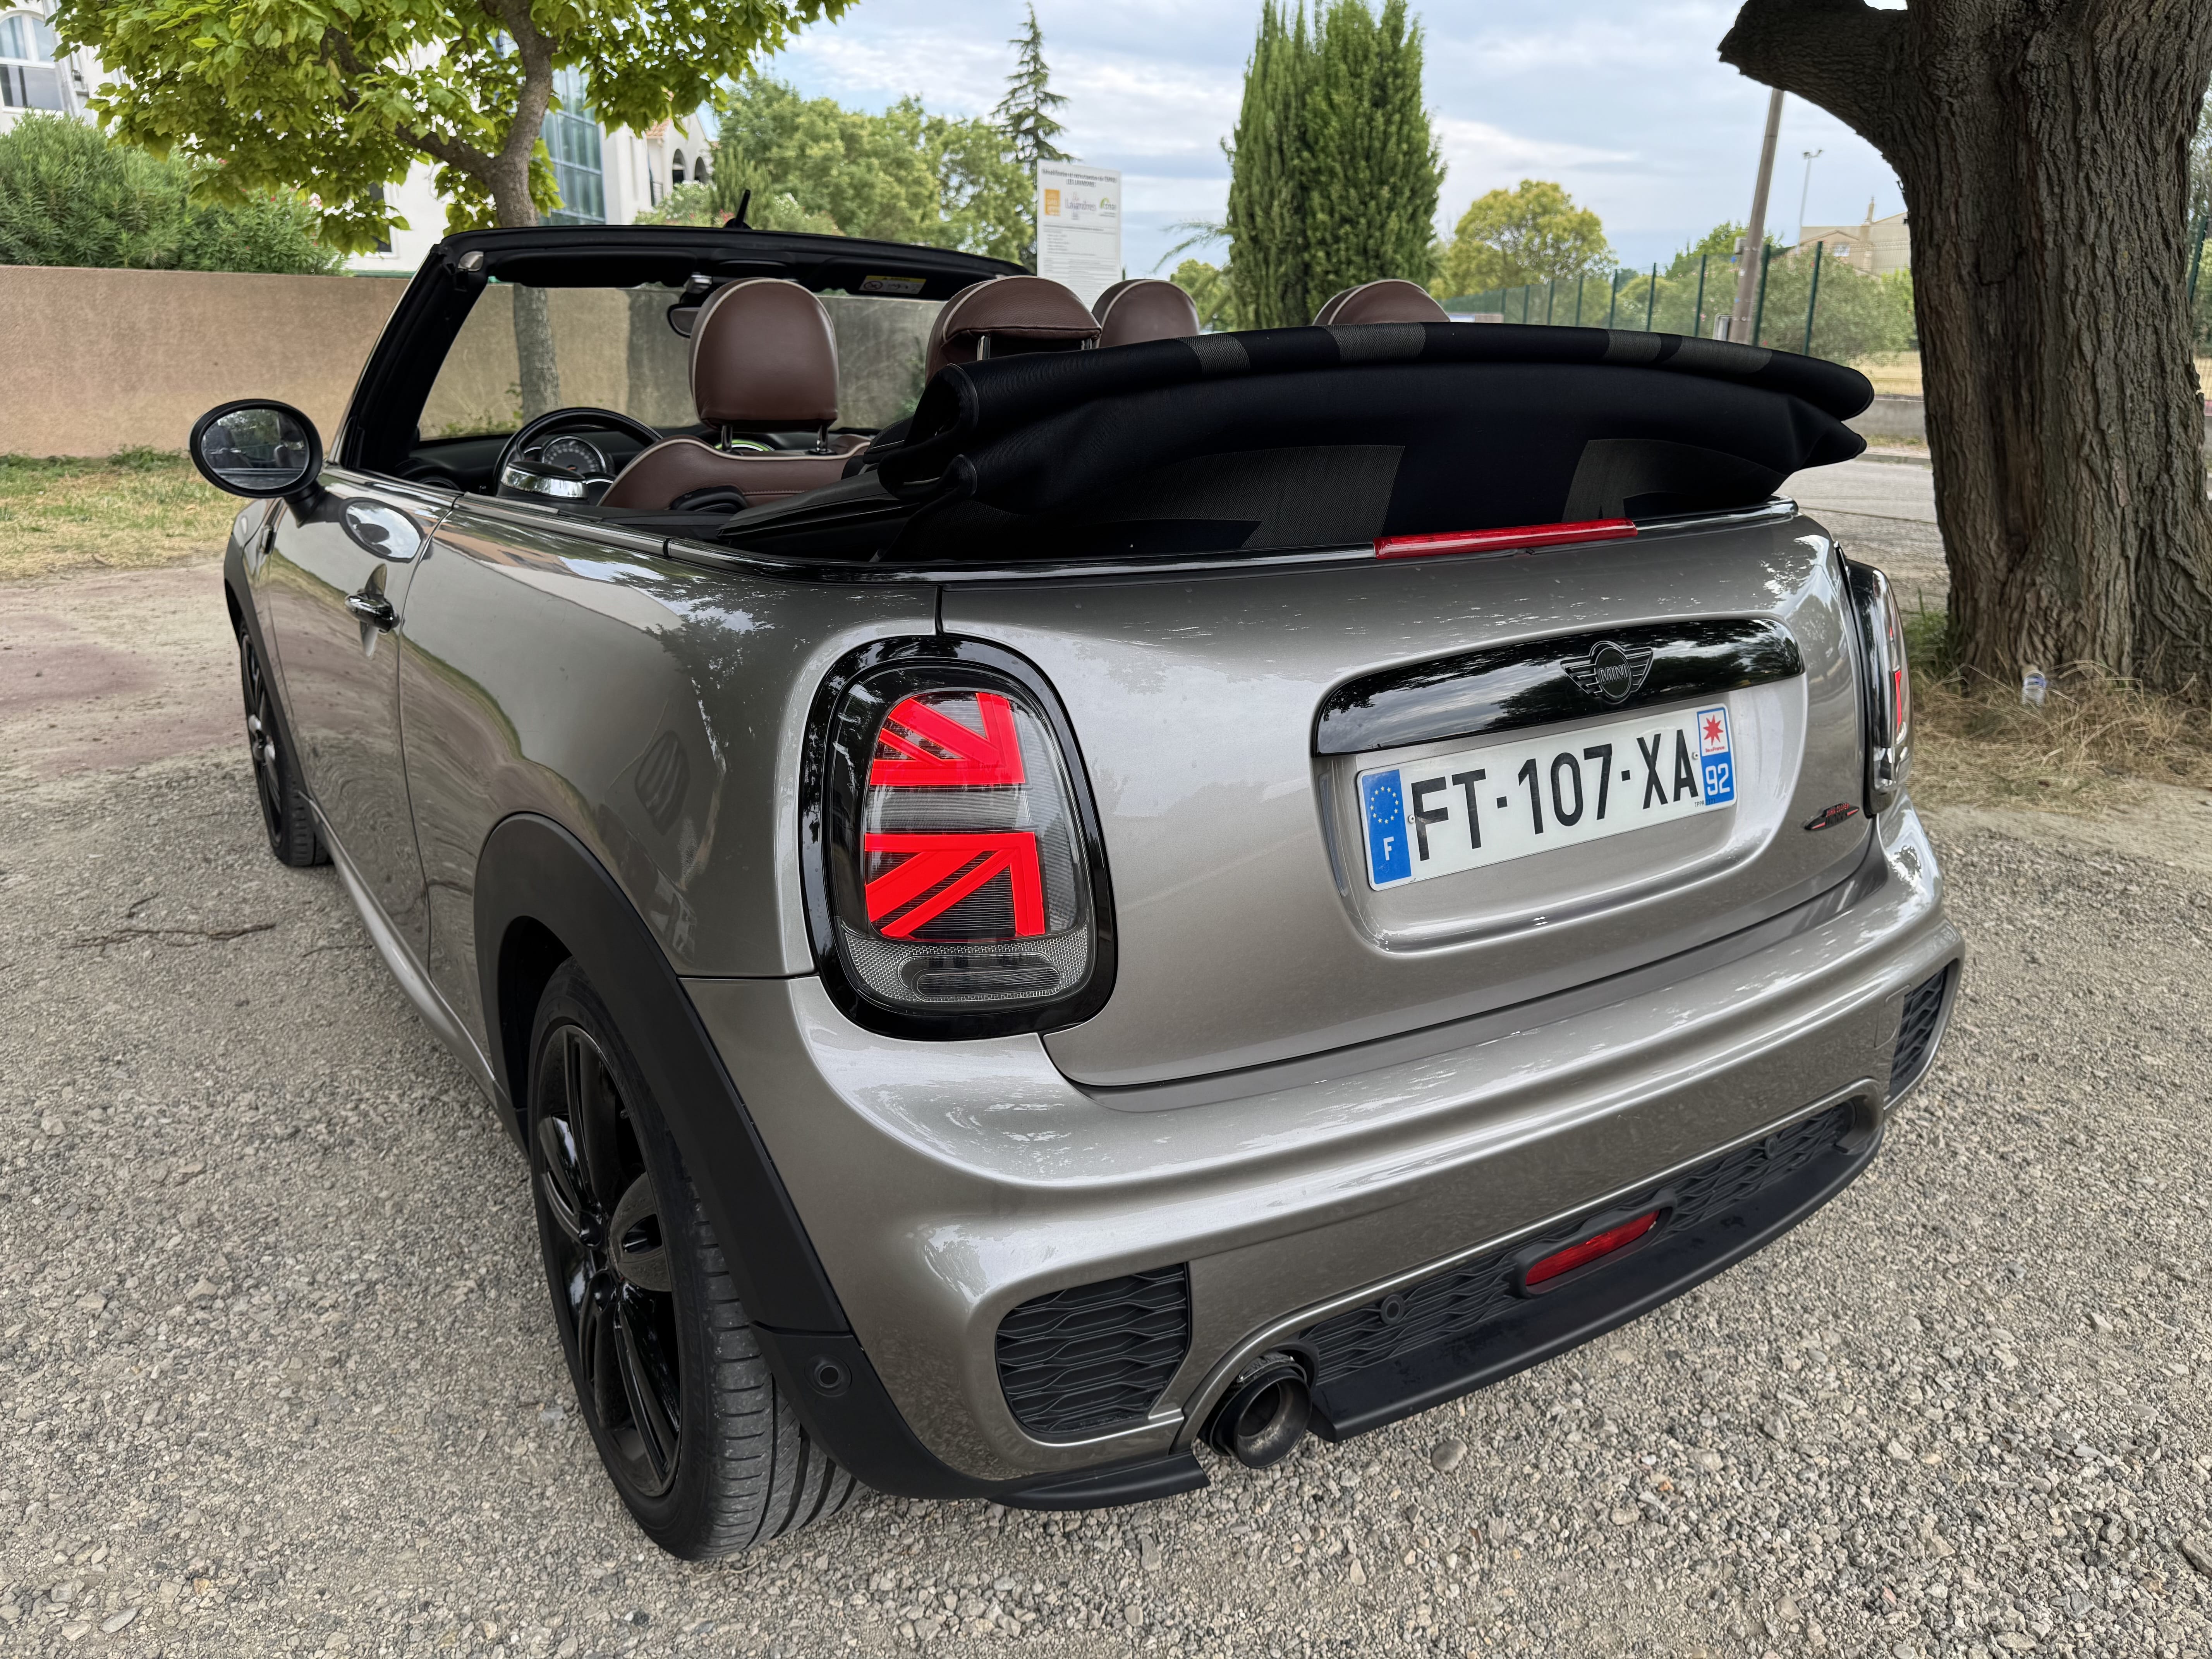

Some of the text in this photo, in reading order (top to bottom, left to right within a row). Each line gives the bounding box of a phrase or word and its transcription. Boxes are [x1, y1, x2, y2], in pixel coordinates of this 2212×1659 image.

[1598, 664, 1628, 684] MINI
[1705, 763, 1730, 796] 92
[1411, 729, 1698, 862] FT-107-XA
[1383, 836, 1394, 860] F
